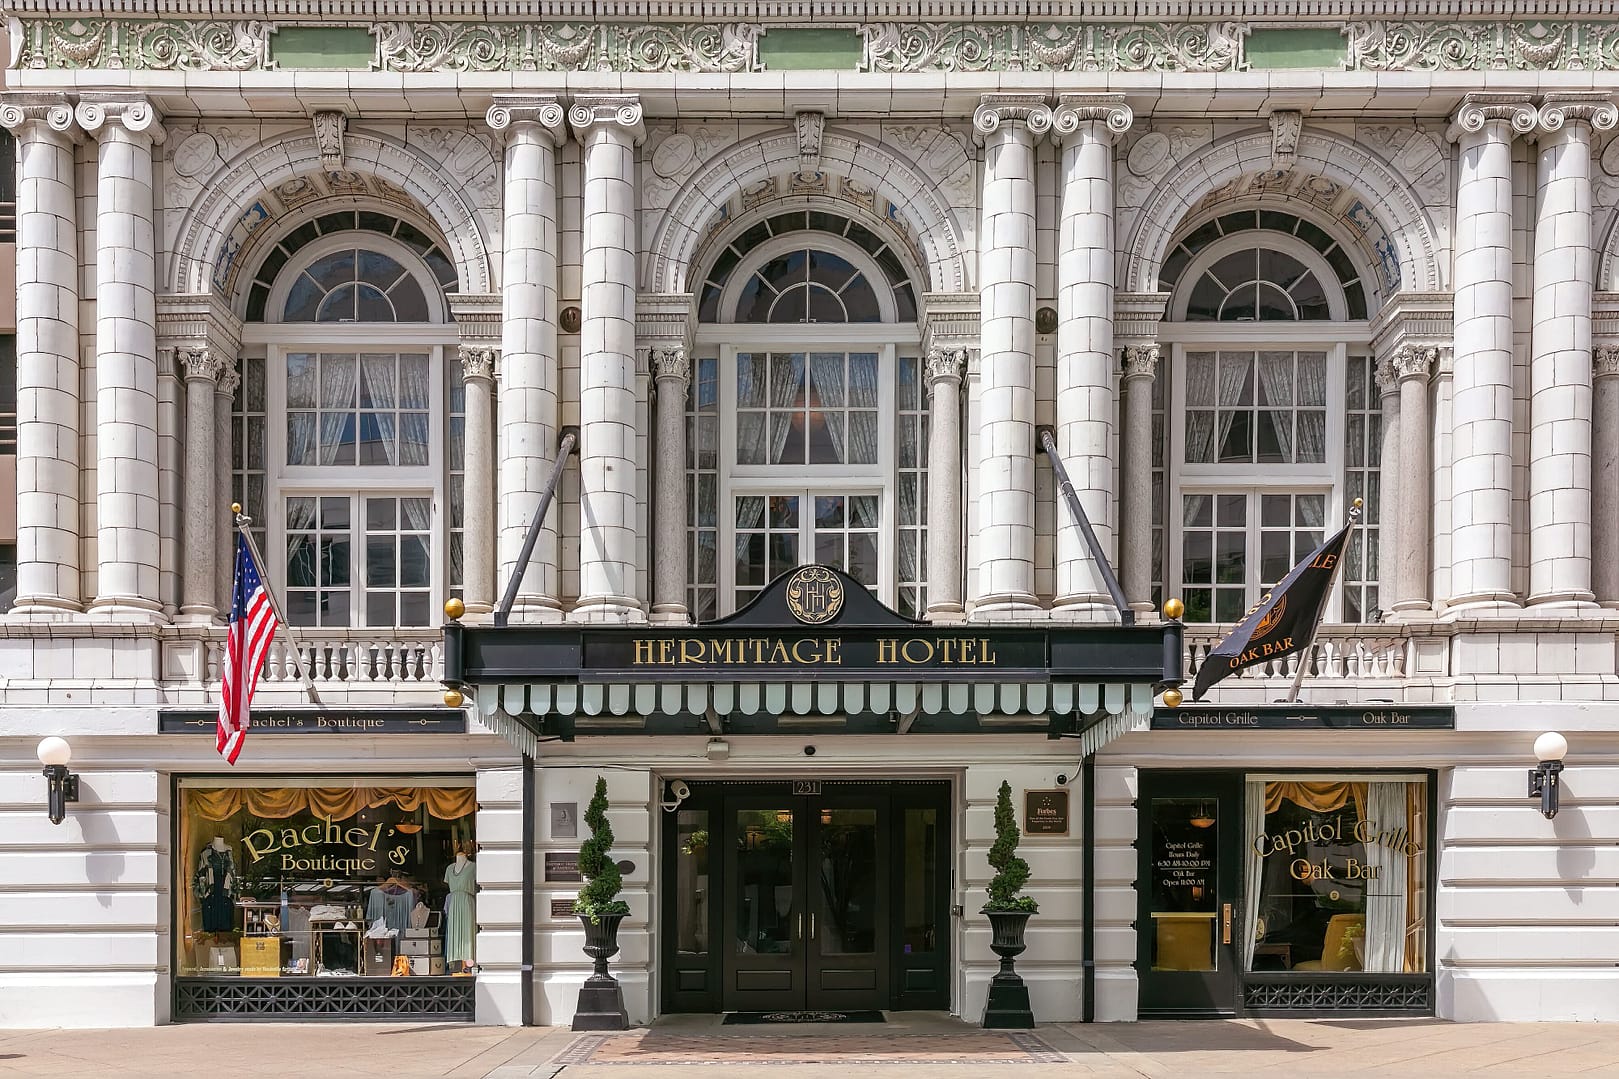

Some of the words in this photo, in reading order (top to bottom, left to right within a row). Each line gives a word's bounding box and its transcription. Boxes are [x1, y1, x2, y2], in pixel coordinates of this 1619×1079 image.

[632, 637, 841, 665] HERMITAGE
[876, 637, 996, 664] HOTEL
[1229, 648, 1259, 668] OAK
[1263, 637, 1295, 656] BAR
[252, 716, 304, 727] achel's
[317, 716, 385, 731] Boutique
[1178, 711, 1221, 728] Capitol
[1225, 711, 1259, 725] Grille
[1362, 711, 1387, 724] Oak
[1391, 711, 1411, 724] Bar
[797, 781, 816, 793] 231
[240, 814, 410, 865] Rachel's
[1252, 814, 1343, 858] Capitol
[1353, 819, 1423, 858] Grille
[280, 853, 376, 876] Boutique
[1290, 858, 1334, 880] Oak
[1345, 858, 1383, 880] Bar
